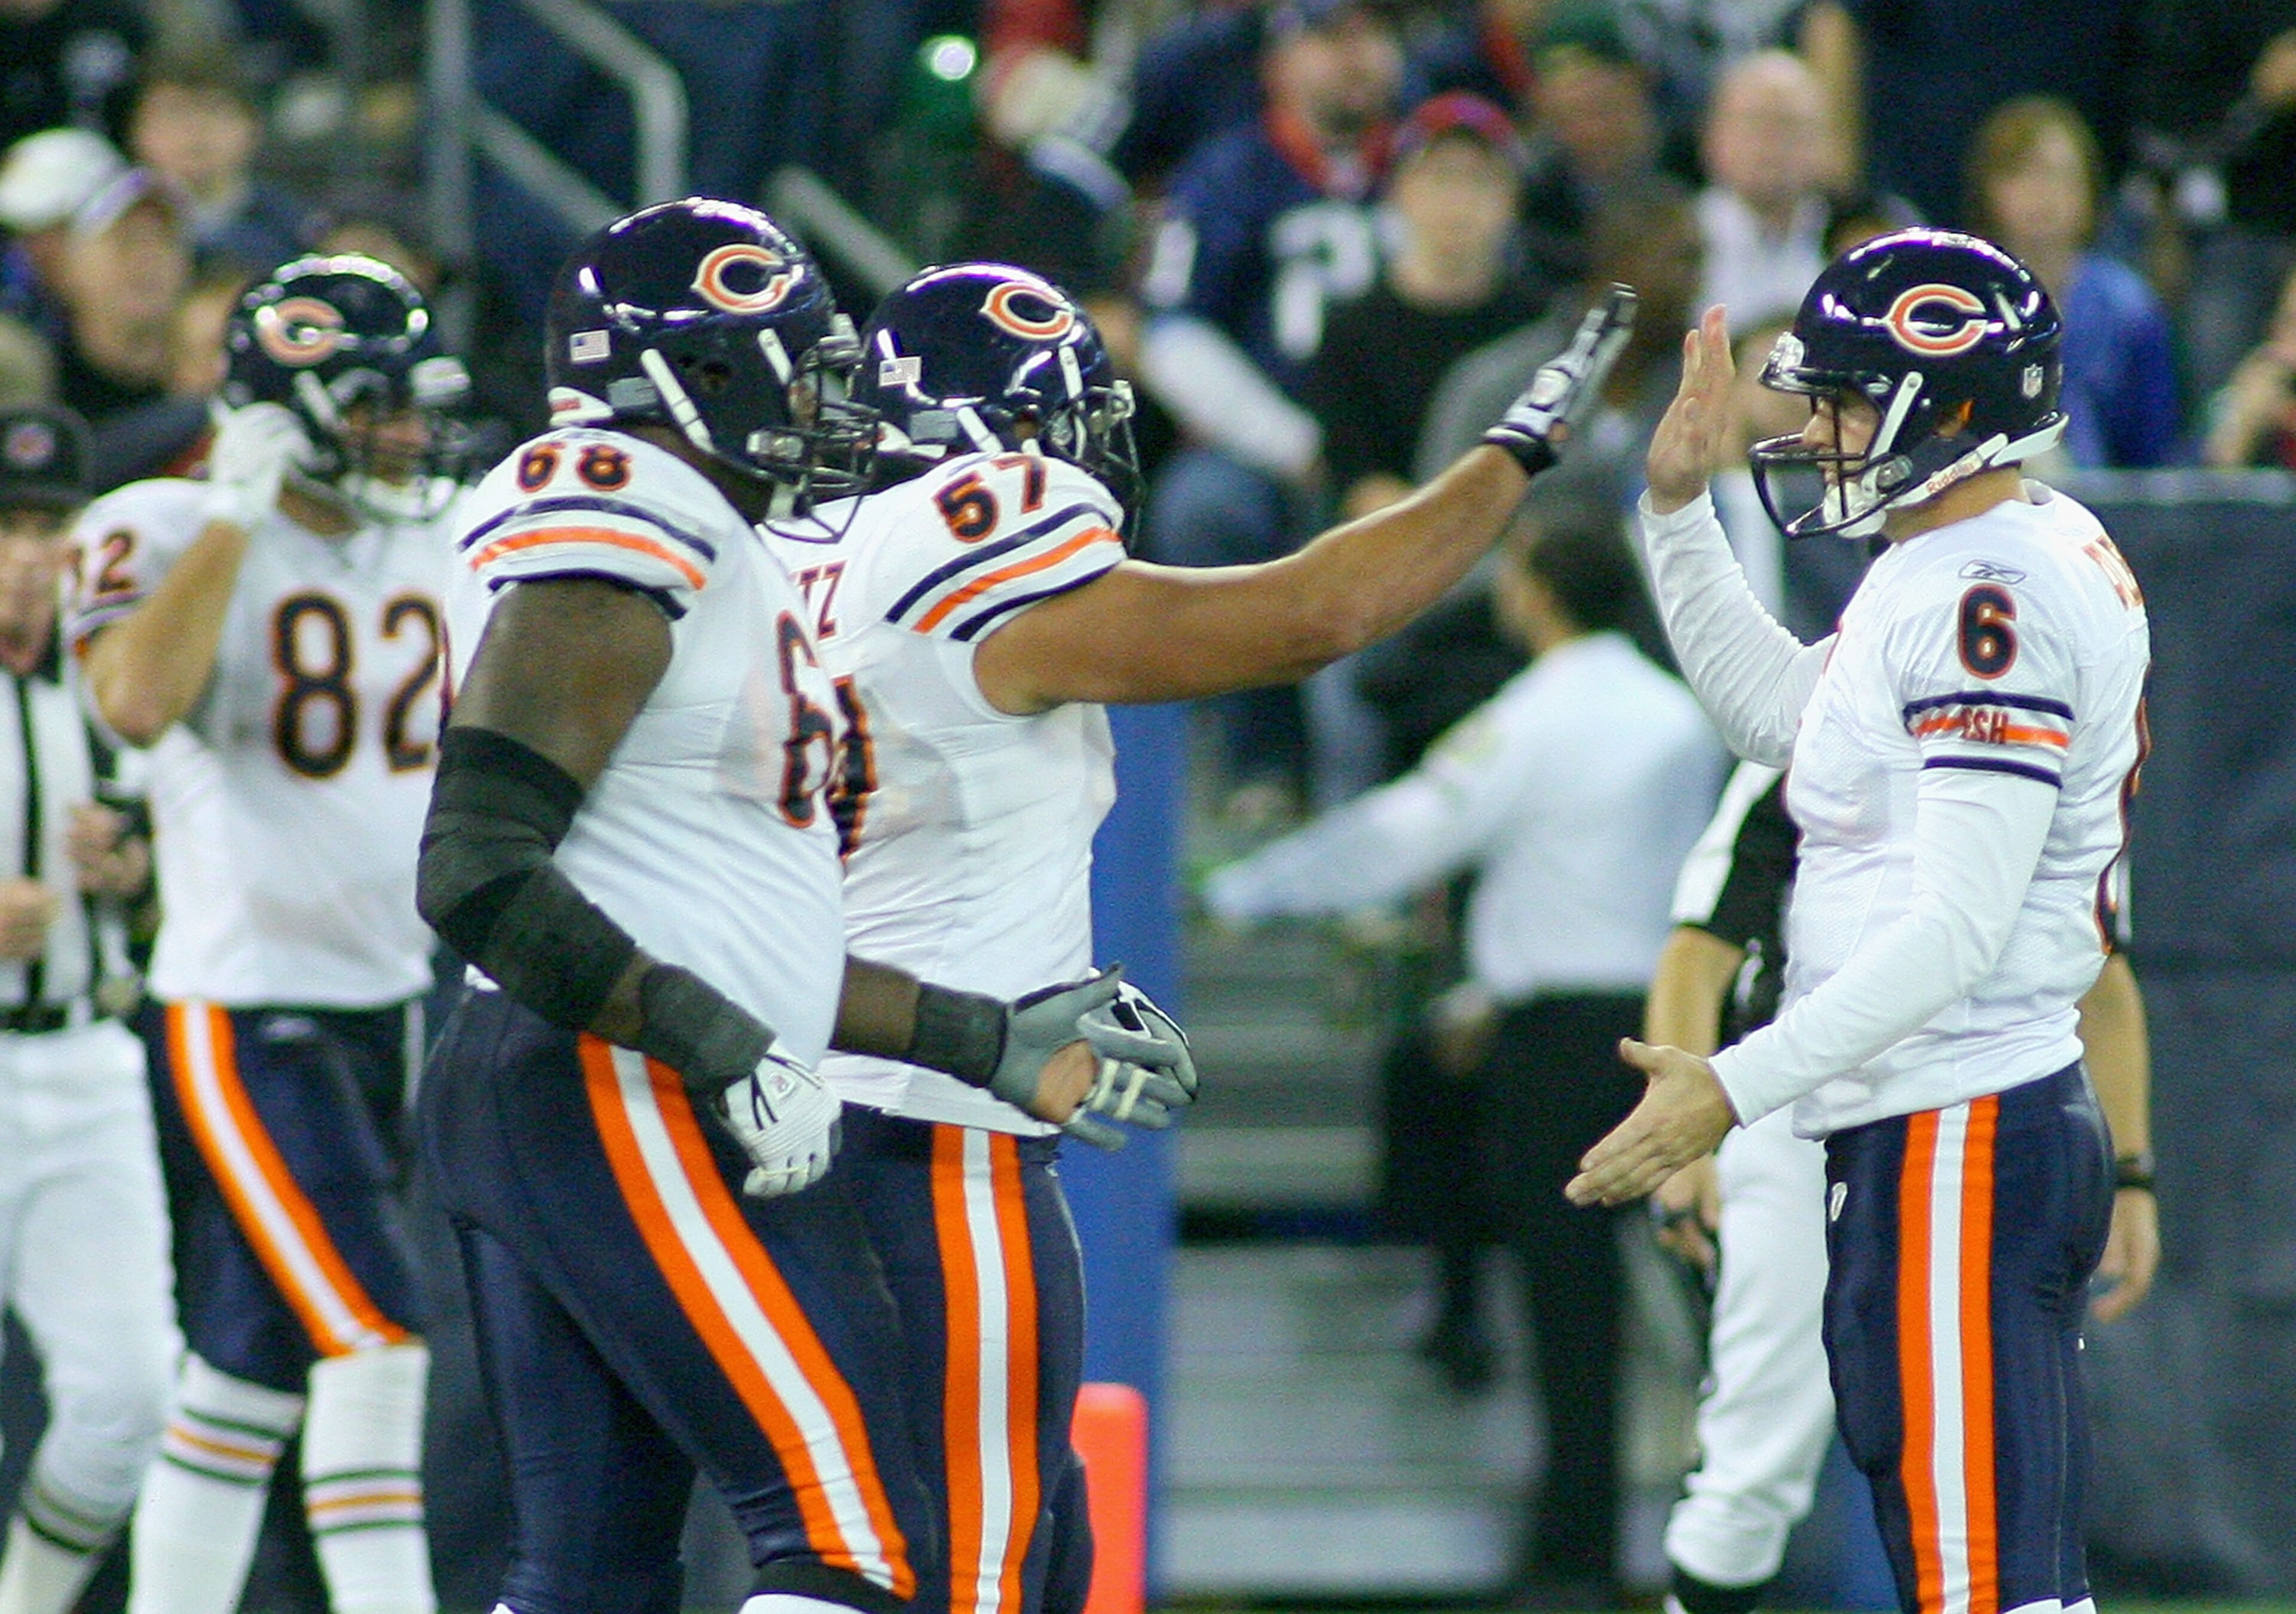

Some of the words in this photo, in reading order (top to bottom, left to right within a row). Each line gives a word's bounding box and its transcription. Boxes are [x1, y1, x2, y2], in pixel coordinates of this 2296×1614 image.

[516, 441, 634, 494] 68
[930, 453, 1048, 544] 57
[1957, 582, 2018, 680] 6
[274, 590, 439, 778] 82
